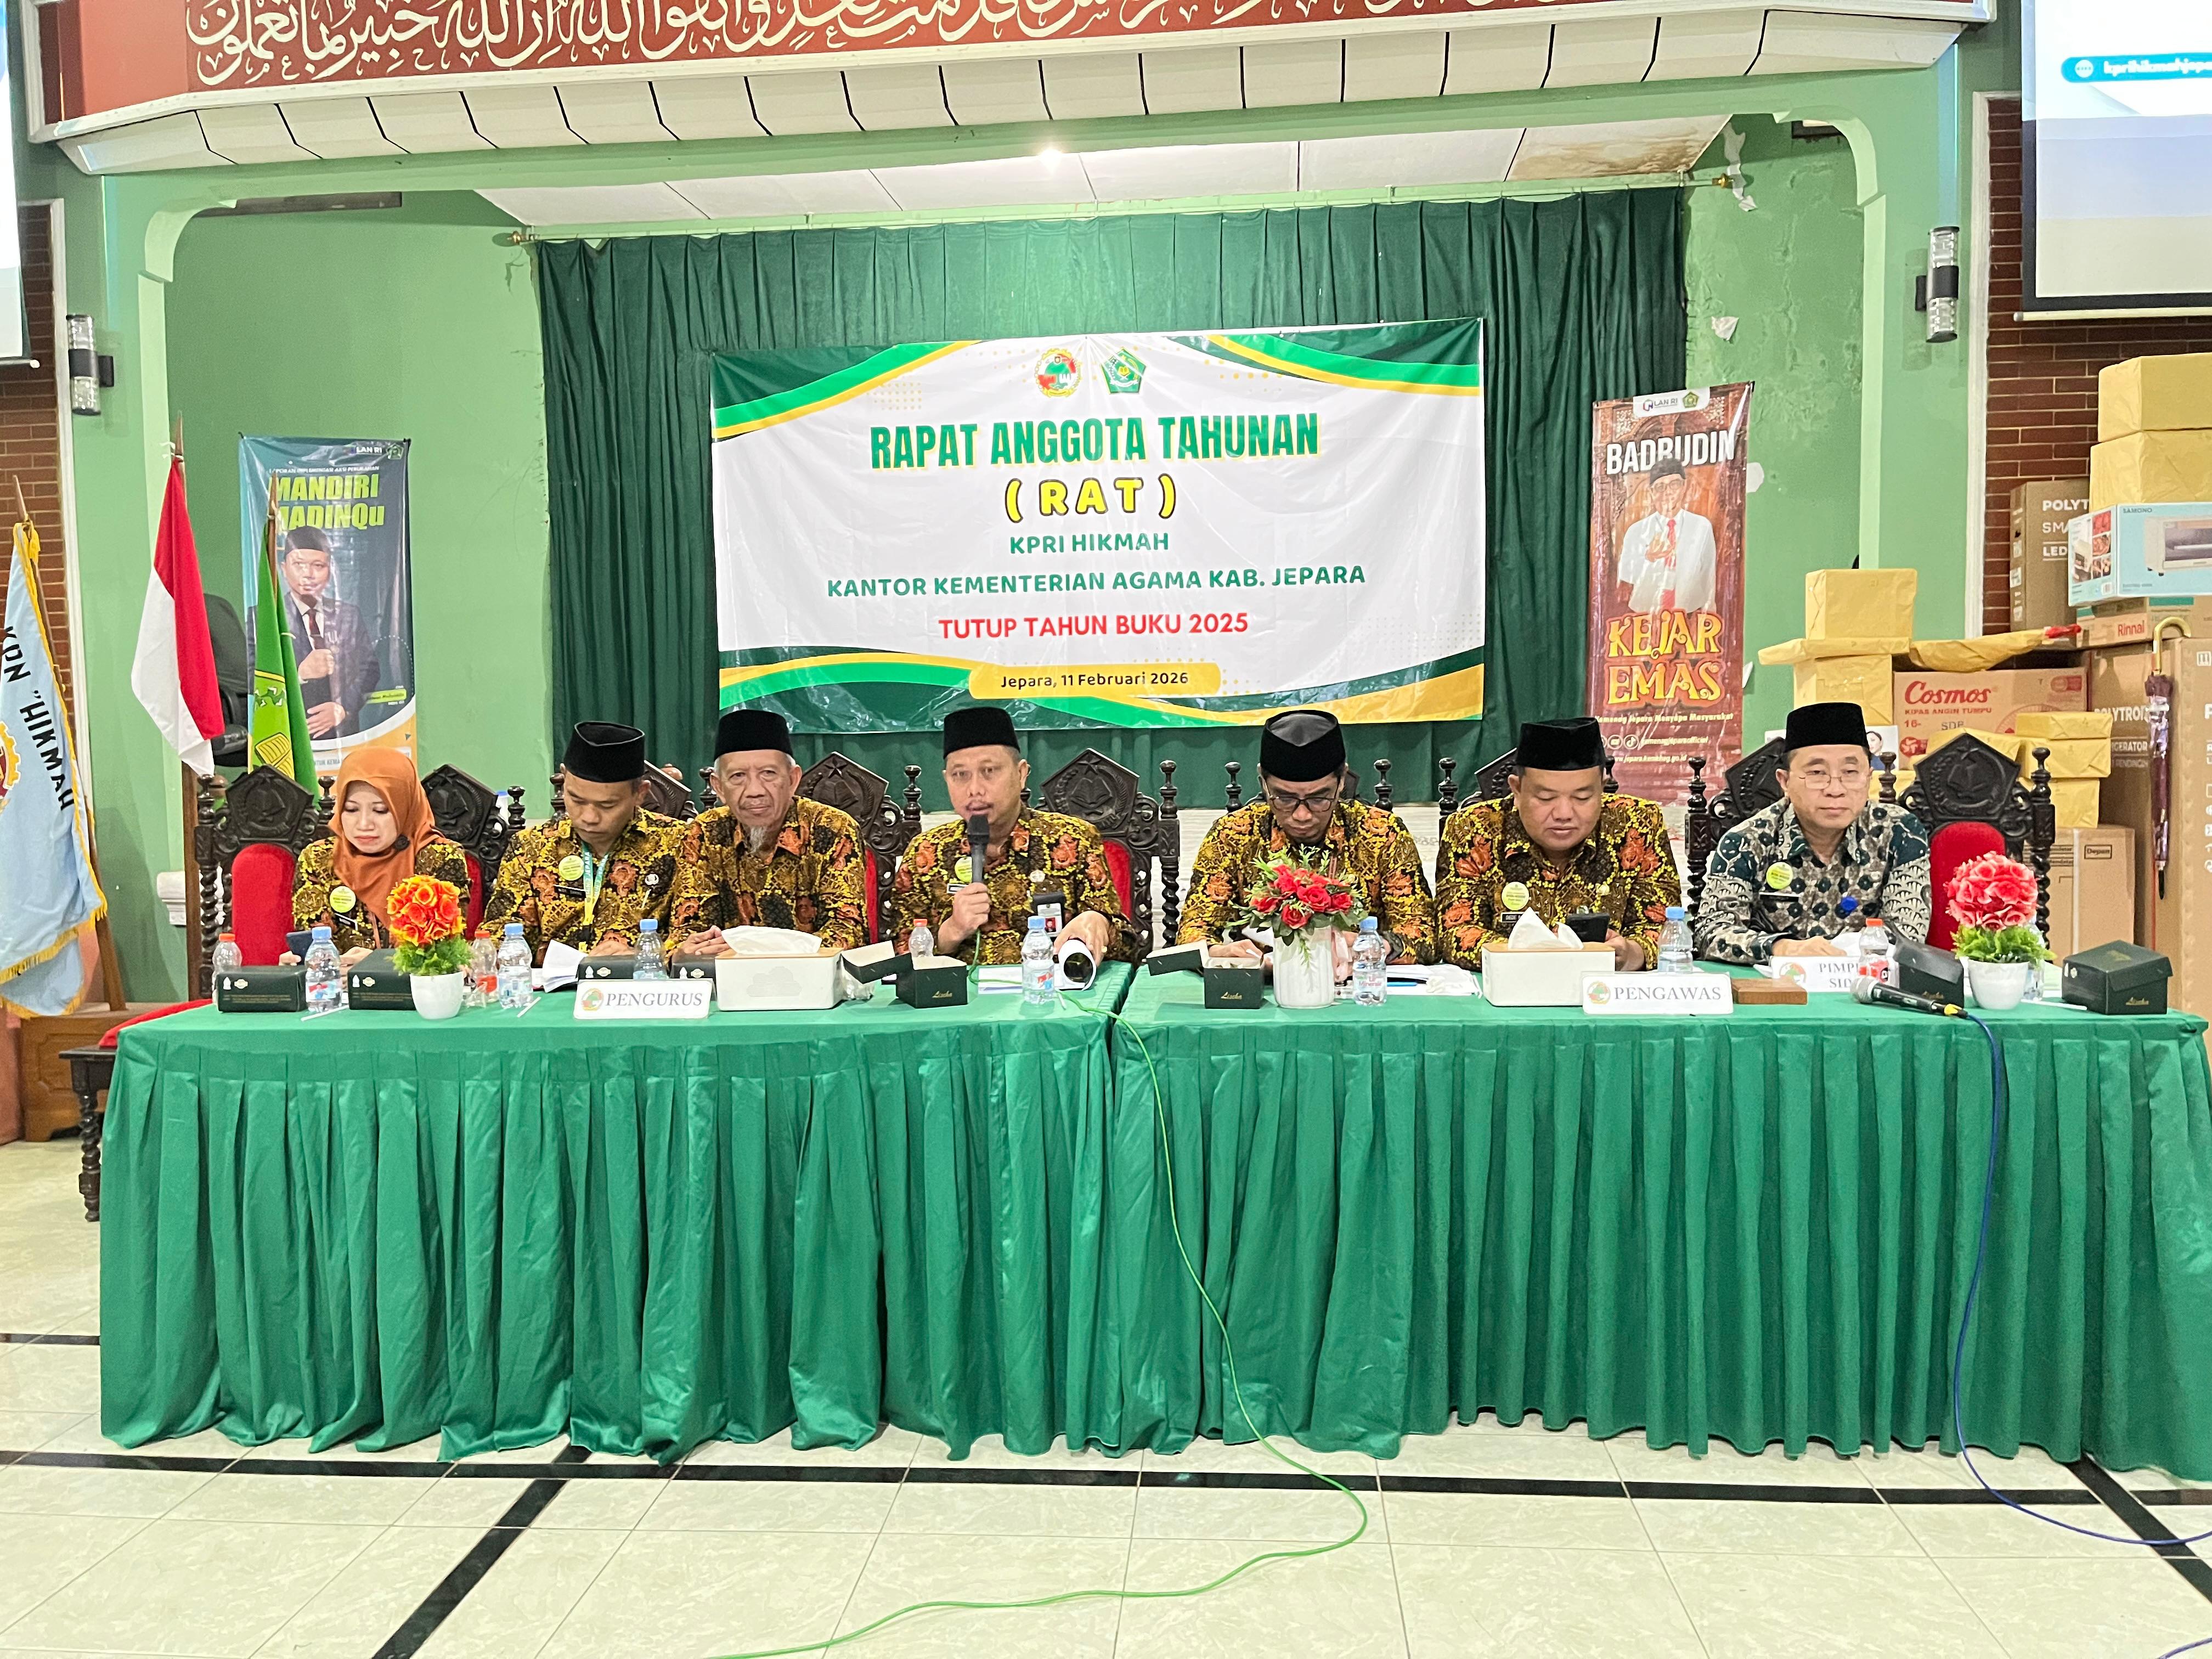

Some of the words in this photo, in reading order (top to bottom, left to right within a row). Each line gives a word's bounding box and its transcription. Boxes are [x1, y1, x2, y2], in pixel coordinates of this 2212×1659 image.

[871, 424, 979, 470] RAPAT
[990, 417, 1147, 465] ANGGOTA
[1158, 413, 1319, 460] TAHUNAN
[1010, 535, 1064, 554] KPRI
[1072, 533, 1169, 552] HIKMAH
[2042, 546, 2067, 556] LED
[827, 577, 927, 597] KANTOR
[934, 572, 1105, 595] KEMENTERIAN
[1112, 570, 1202, 590] AGAMA
[1209, 568, 1265, 588] KAB.
[1271, 565, 1366, 586] JEPARA
[938, 617, 1018, 640] TUTUP
[1024, 615, 1107, 637] TAHUN
[1115, 613, 1182, 635] BUKU
[1189, 612, 1249, 634] 2025
[1608, 610, 1722, 659] KEJAR
[1001, 675, 1056, 691] Jepara,
[1061, 675, 1074, 687] 11
[1078, 672, 1146, 686] Februari
[1150, 672, 1189, 685] 2026
[1608, 662, 1721, 704] EMAS
[1905, 681, 1991, 705] Cosmos
[606, 992, 703, 1007] PENGURUS
[1614, 986, 1722, 1001] PENGAWAS
